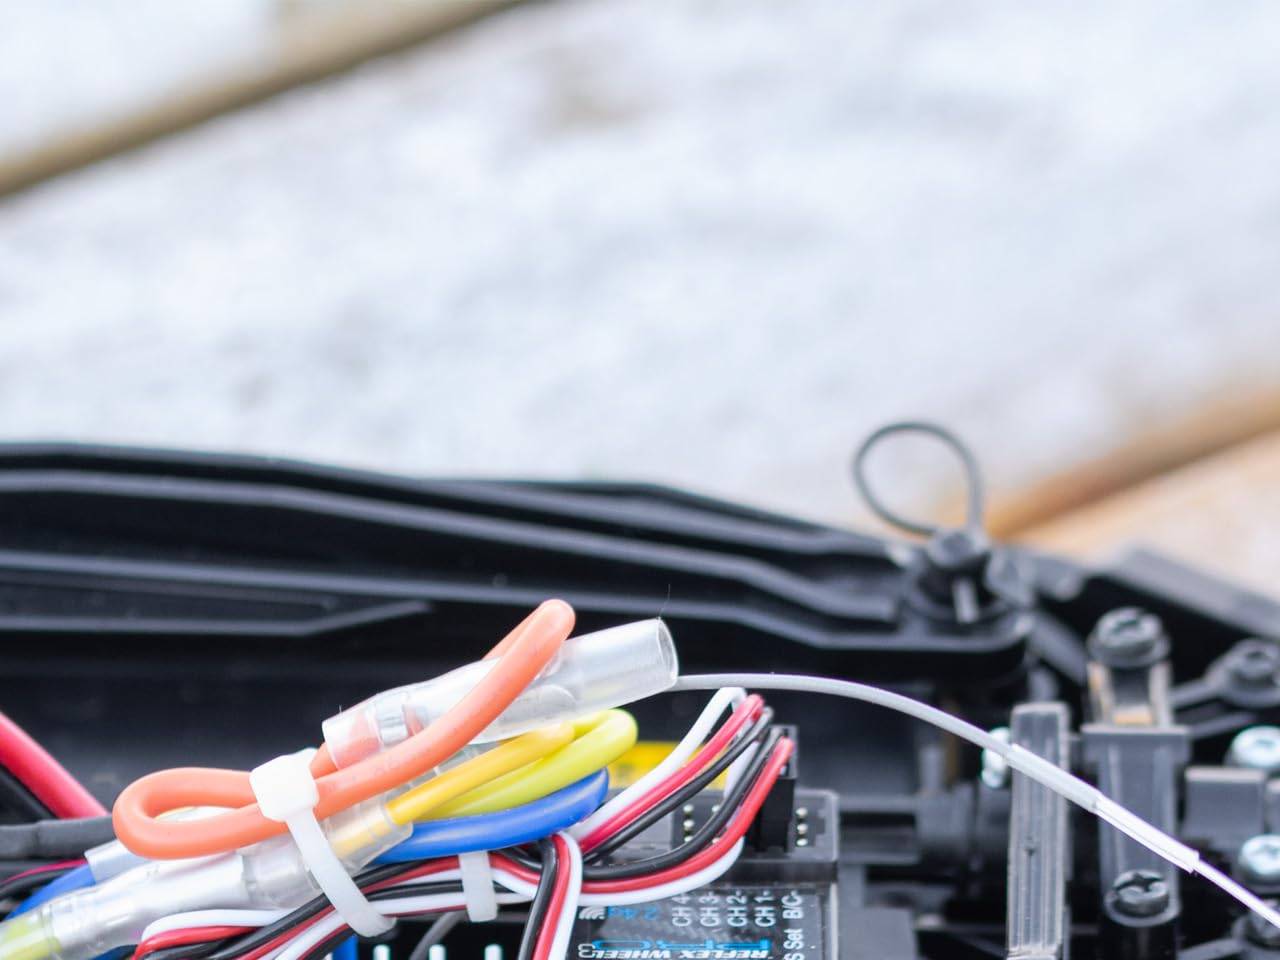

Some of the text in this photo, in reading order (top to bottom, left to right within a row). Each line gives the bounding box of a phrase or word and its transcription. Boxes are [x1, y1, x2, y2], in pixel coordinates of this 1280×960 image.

[672, 907, 692, 927] CH
[700, 907, 720, 927] CH
[727, 907, 747, 927] CH
[755, 907, 775, 927] CH
[784, 928, 804, 949] Set
[592, 949, 769, 960] REFLEX WHEEL
